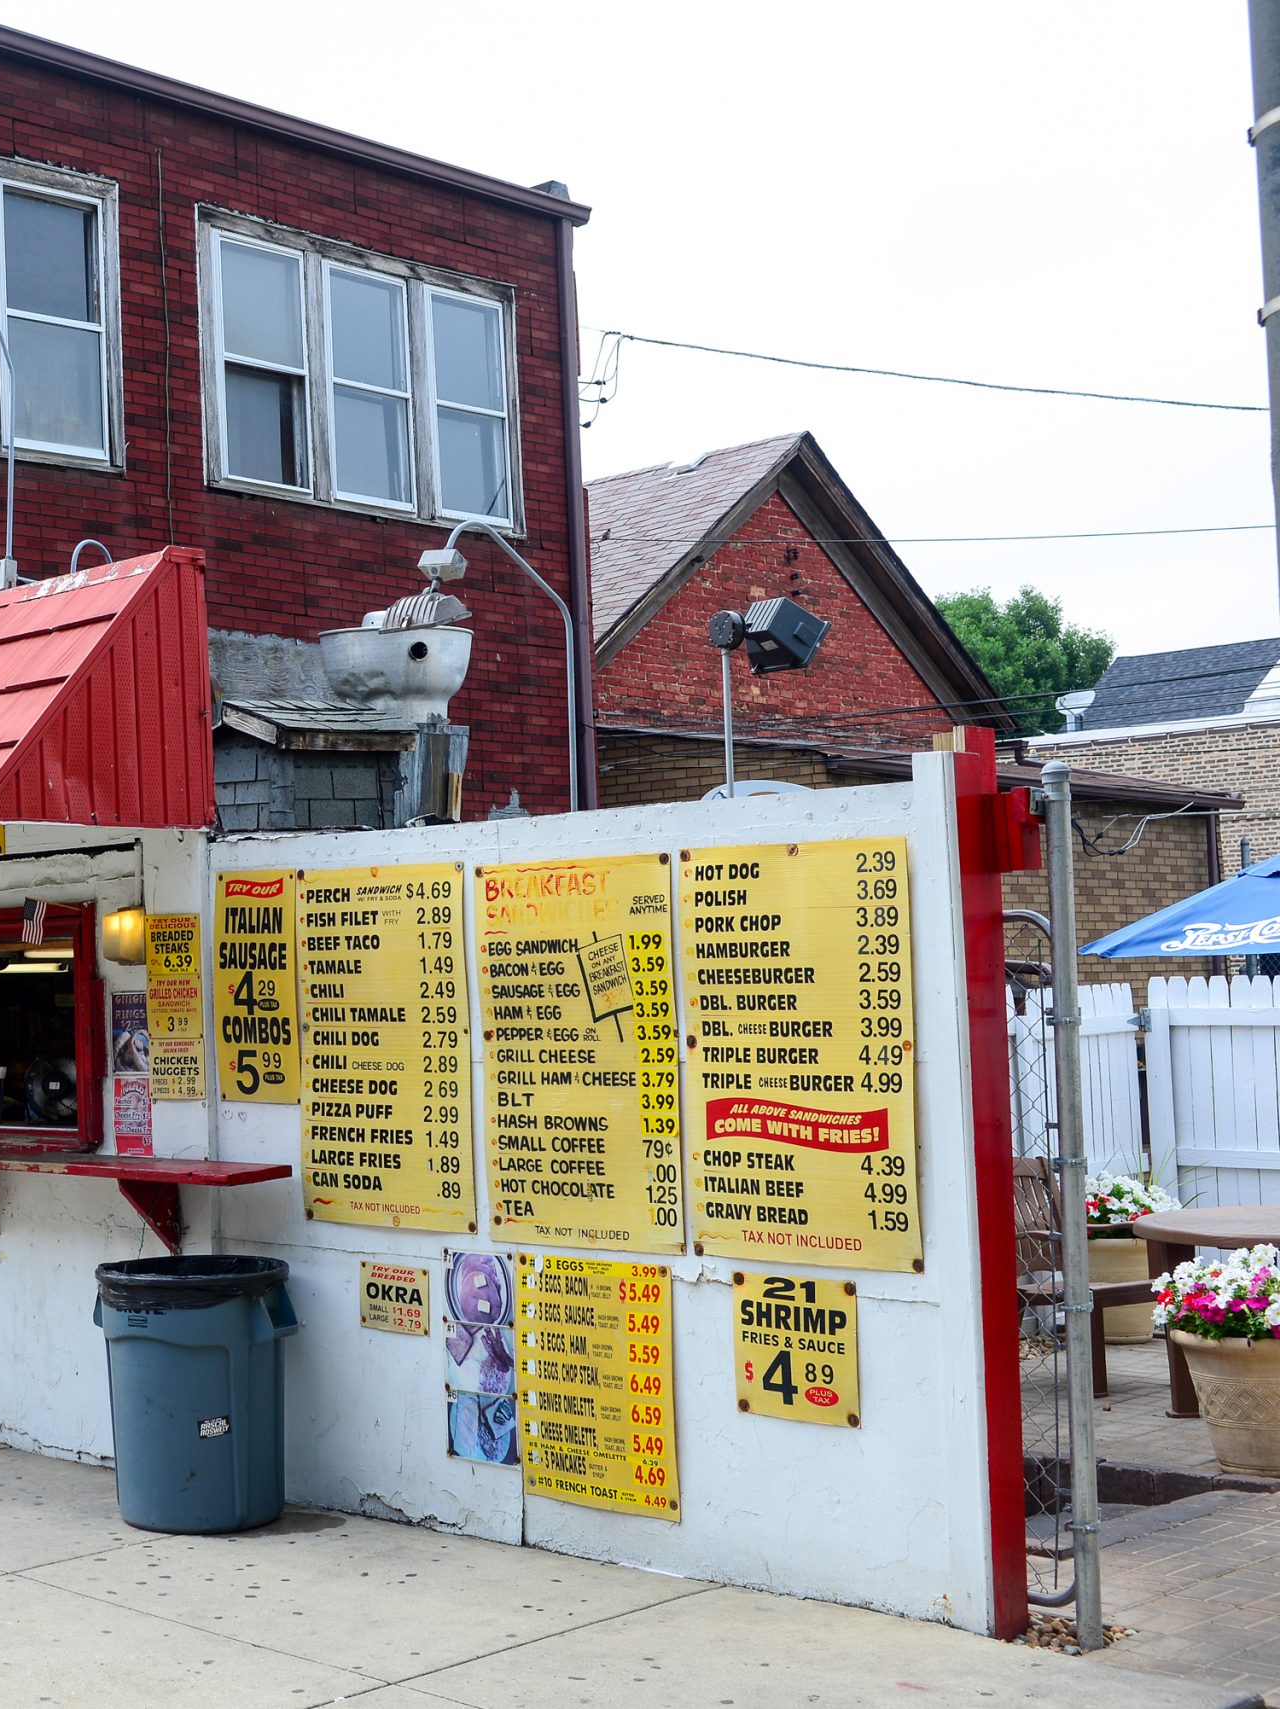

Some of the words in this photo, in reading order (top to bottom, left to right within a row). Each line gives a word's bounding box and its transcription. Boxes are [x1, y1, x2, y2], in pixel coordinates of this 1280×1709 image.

[695, 866, 723, 881] HOT
[729, 863, 759, 880] DOG
[856, 851, 895, 873] 2.39
[307, 888, 350, 904] PERCH
[356, 885, 402, 895] SANDWICH
[406, 881, 451, 900] $4.69
[633, 895, 665, 905] SERVED
[695, 890, 747, 907] POLISH
[856, 879, 896, 900] 3.69
[225, 907, 283, 934] ITALIAN
[307, 912, 335, 927] FISH
[341, 911, 378, 926] FILET
[417, 907, 451, 925] 2.89
[630, 905, 667, 916] ANYTIME
[219, 942, 286, 970] SAUSAGE
[488, 942, 511, 956] EGG
[516, 939, 578, 955] SANDWICH
[629, 934, 662, 950] 1.99
[697, 968, 815, 985] CHEESEBURGER
[859, 962, 901, 983] 2.59
[223, 1016, 291, 1045] COMBOS
[153, 1067, 199, 1075] NUGGETS
[154, 1057, 198, 1066] CHICKEN
[498, 1114, 537, 1129] HASH
[544, 1116, 608, 1131] BROWNS
[644, 1118, 675, 1133] 1.39
[714, 1118, 761, 1133] COME
[767, 1120, 812, 1140] WITH
[818, 1127, 879, 1144] FRIES!
[312, 1126, 364, 1142] FRENCH
[371, 1130, 413, 1145] FRIES
[425, 1131, 459, 1149] 1.49
[546, 1259, 552, 1269] 3
[556, 1260, 584, 1272] EGGS
[366, 1282, 423, 1306] OKRA
[763, 1277, 815, 1303] 21
[447, 1324, 455, 1333] #1
[741, 1299, 846, 1336] SHRIMP
[742, 1331, 779, 1346] FRIES
[784, 1337, 793, 1348] &
[799, 1338, 845, 1354] SAUCE
[448, 1391, 457, 1399] #6
[556, 1479, 587, 1494] FRENCH
[591, 1485, 617, 1499] TOAST
